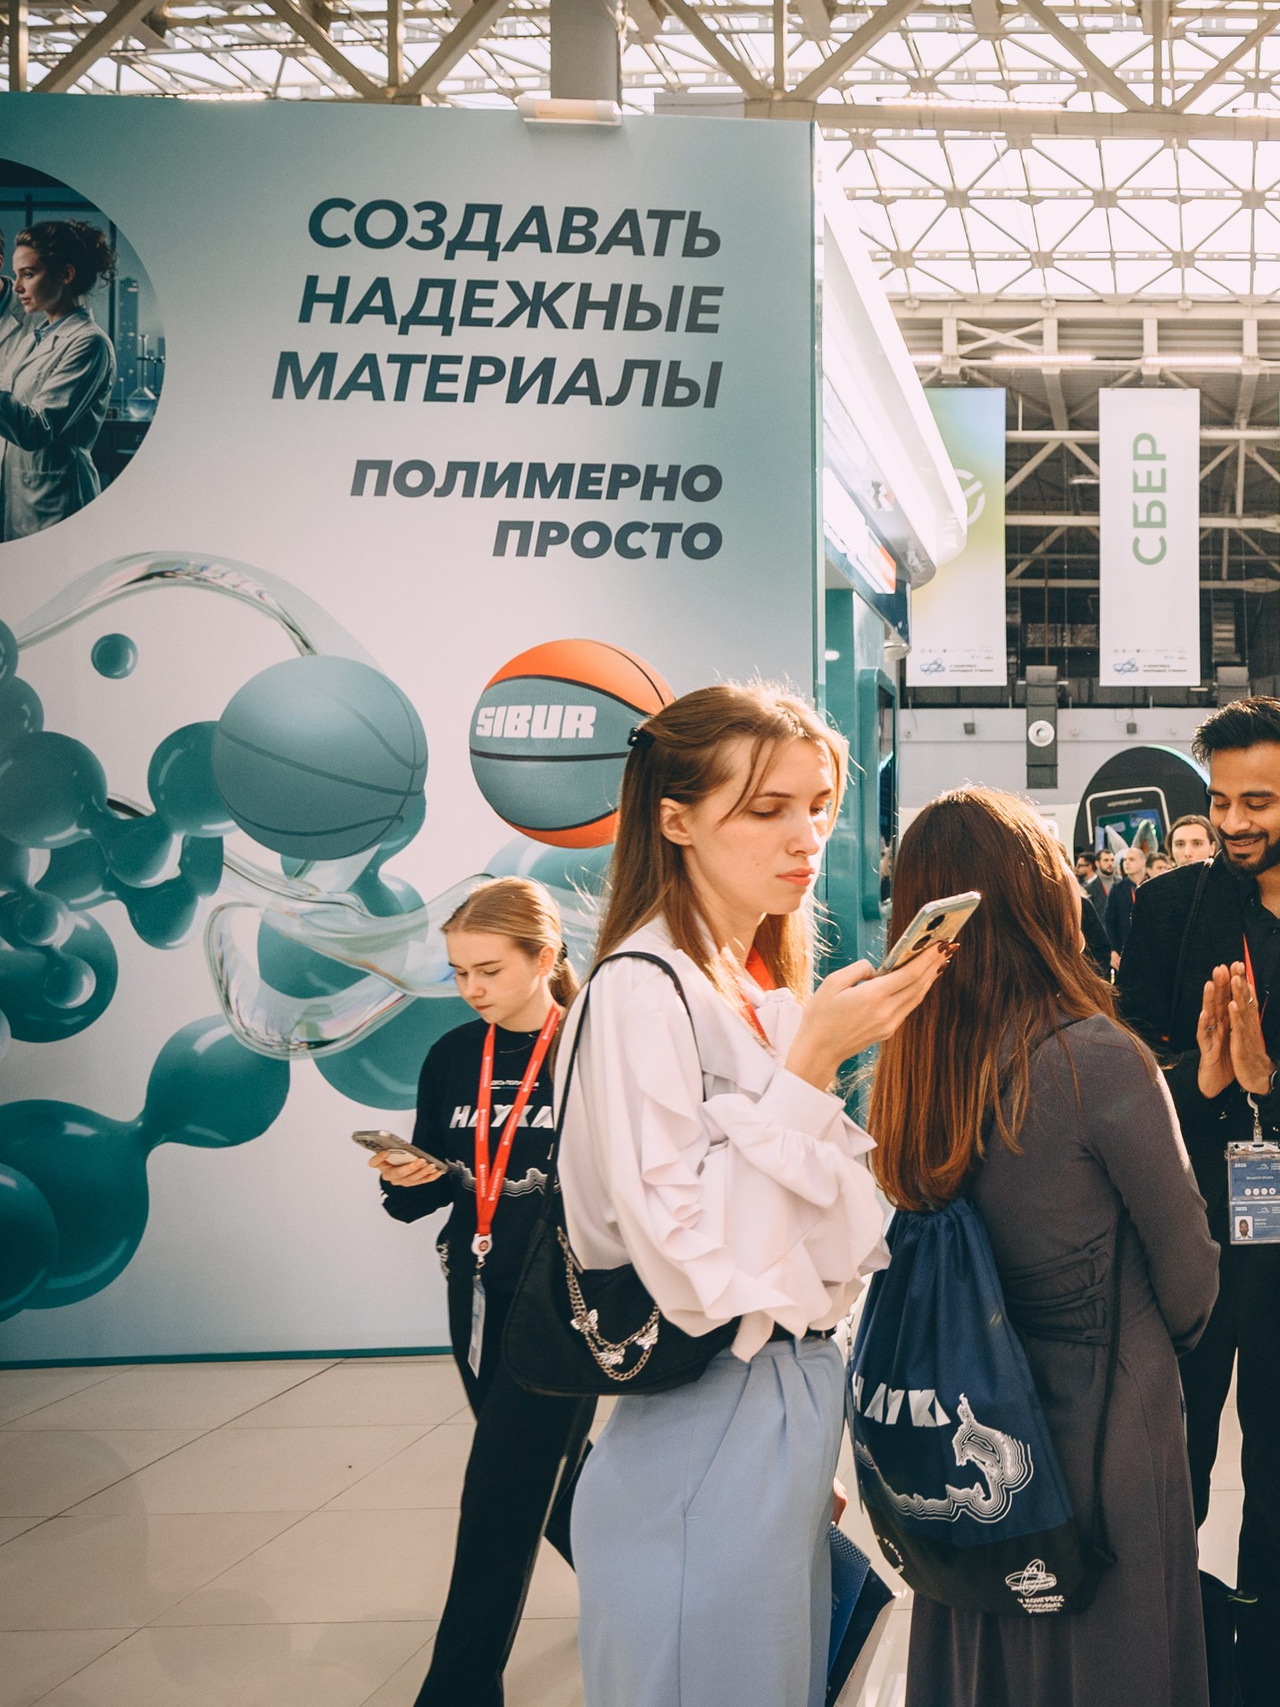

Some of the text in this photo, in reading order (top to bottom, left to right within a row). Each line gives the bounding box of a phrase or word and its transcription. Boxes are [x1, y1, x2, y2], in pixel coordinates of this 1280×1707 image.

[308, 197, 722, 261] СОЗДАВАТЬ
[298, 274, 725, 336] НАДЕЖНЫЕ
[272, 351, 723, 408] МАТЕРИАЛЫ
[350, 459, 723, 503] ПОЛИМЕРНО
[1132, 431, 1168, 566] СБЕР
[492, 520, 723, 560] ПРОСТО
[475, 704, 597, 738] SIBUR
